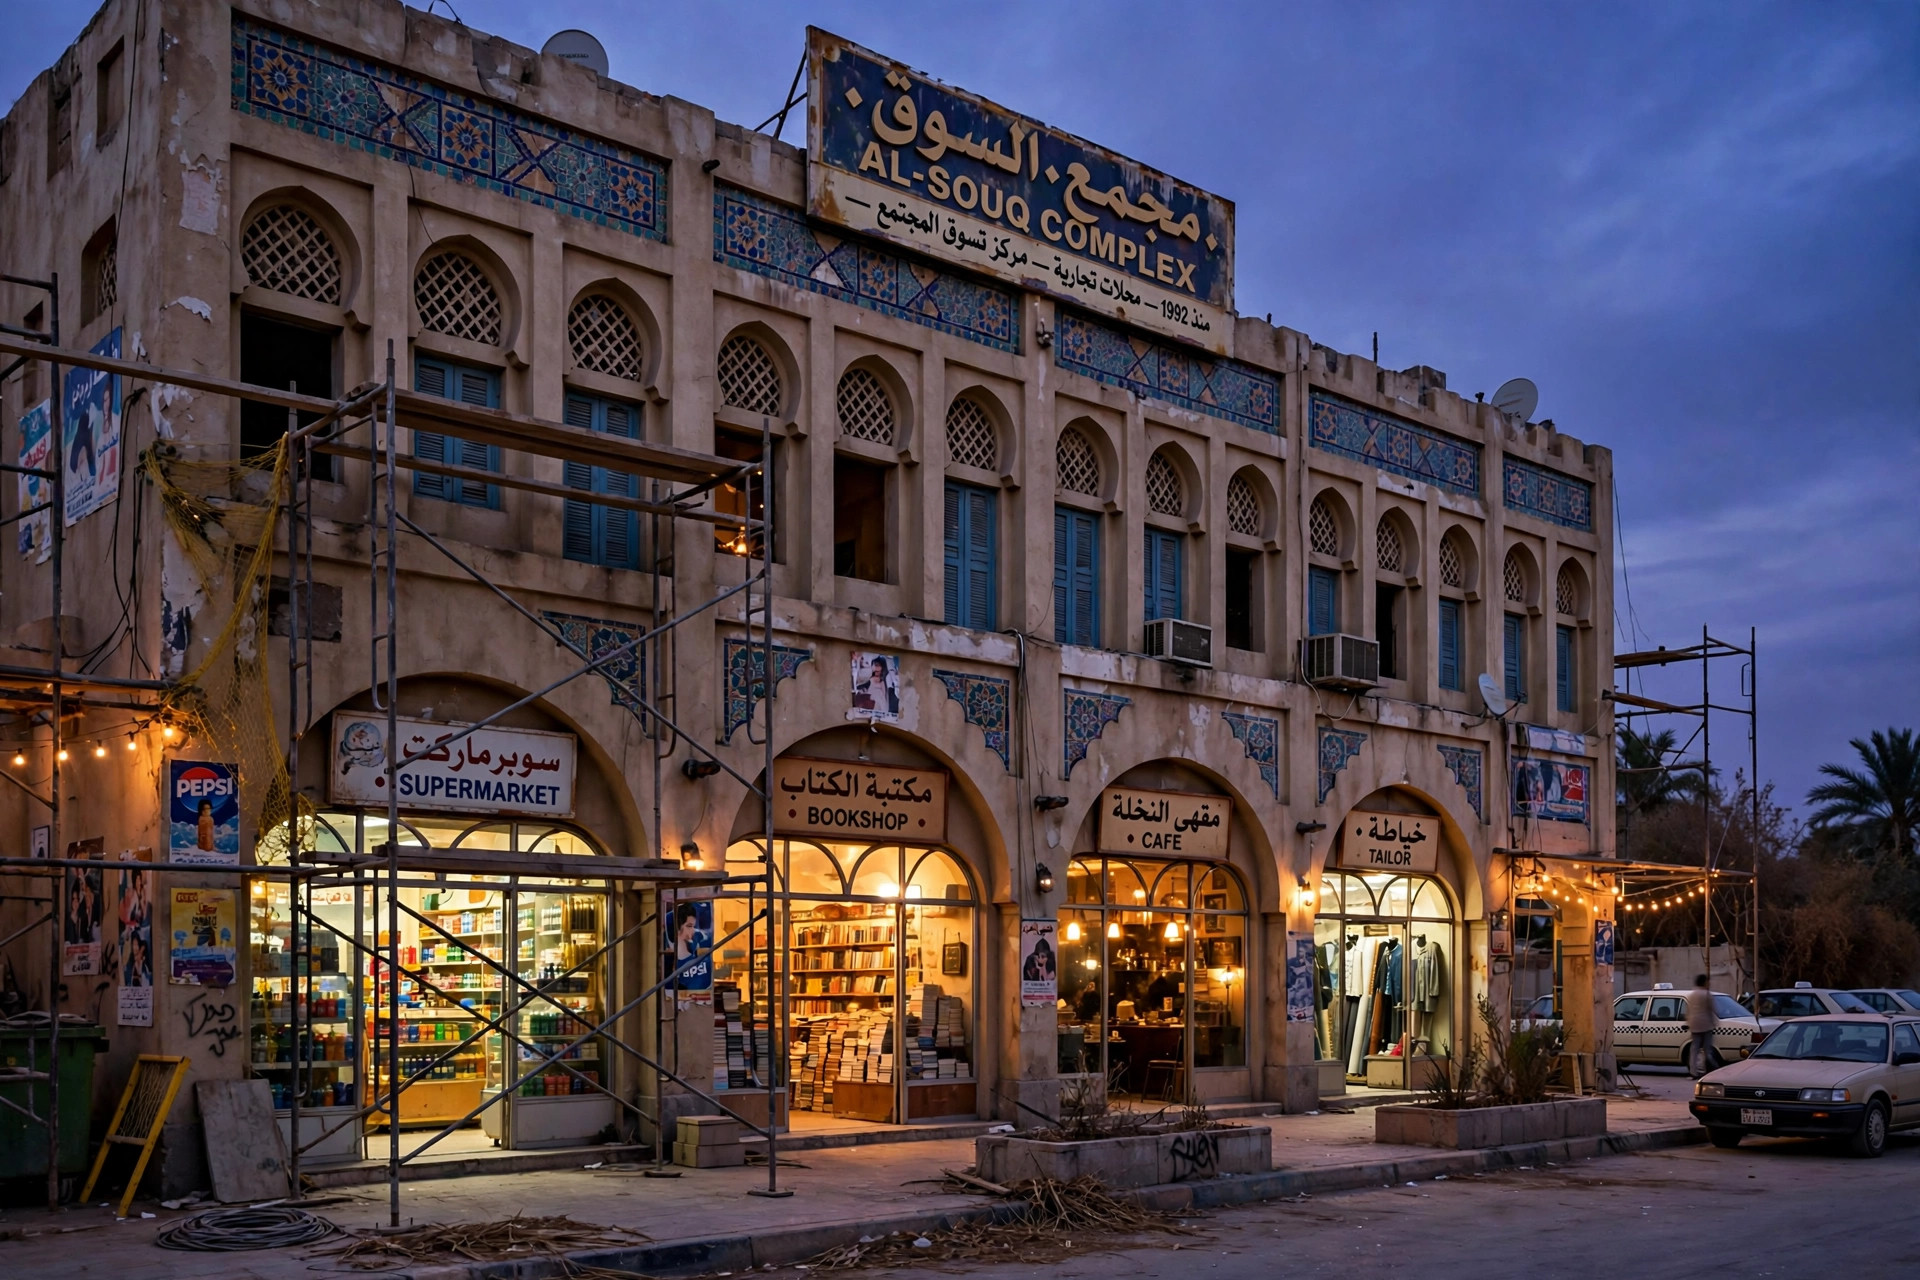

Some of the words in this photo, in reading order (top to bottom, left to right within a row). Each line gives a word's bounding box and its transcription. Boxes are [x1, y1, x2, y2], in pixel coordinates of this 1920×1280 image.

[872, 70, 1039, 183] السوق
[859, 142, 1030, 234] AL-SOUQ
[1041, 208, 1197, 293] COMPLEX
[1064, 161, 1200, 242] مجمع
[877, 202, 939, 235] المجتمع
[943, 217, 987, 251] تسوق
[989, 236, 1028, 268] مركز
[1053, 255, 1097, 293] تجارية
[1100, 277, 1141, 306] محلات
[1160, 299, 1189, 326] 1992
[1191, 308, 1211, 332] منذ
[176, 777, 233, 798] PEPSI
[399, 773, 560, 806] SUPERMARKET
[780, 767, 859, 800] الكتاب
[866, 772, 932, 807] مكتبة
[808, 806, 908, 830] BOOKSHOP
[1112, 794, 1170, 823] النخلة
[1174, 804, 1221, 833] مقهى
[1142, 832, 1182, 850] CAFE
[1369, 816, 1427, 850] خياطة
[1369, 848, 1411, 865] TAILOR
